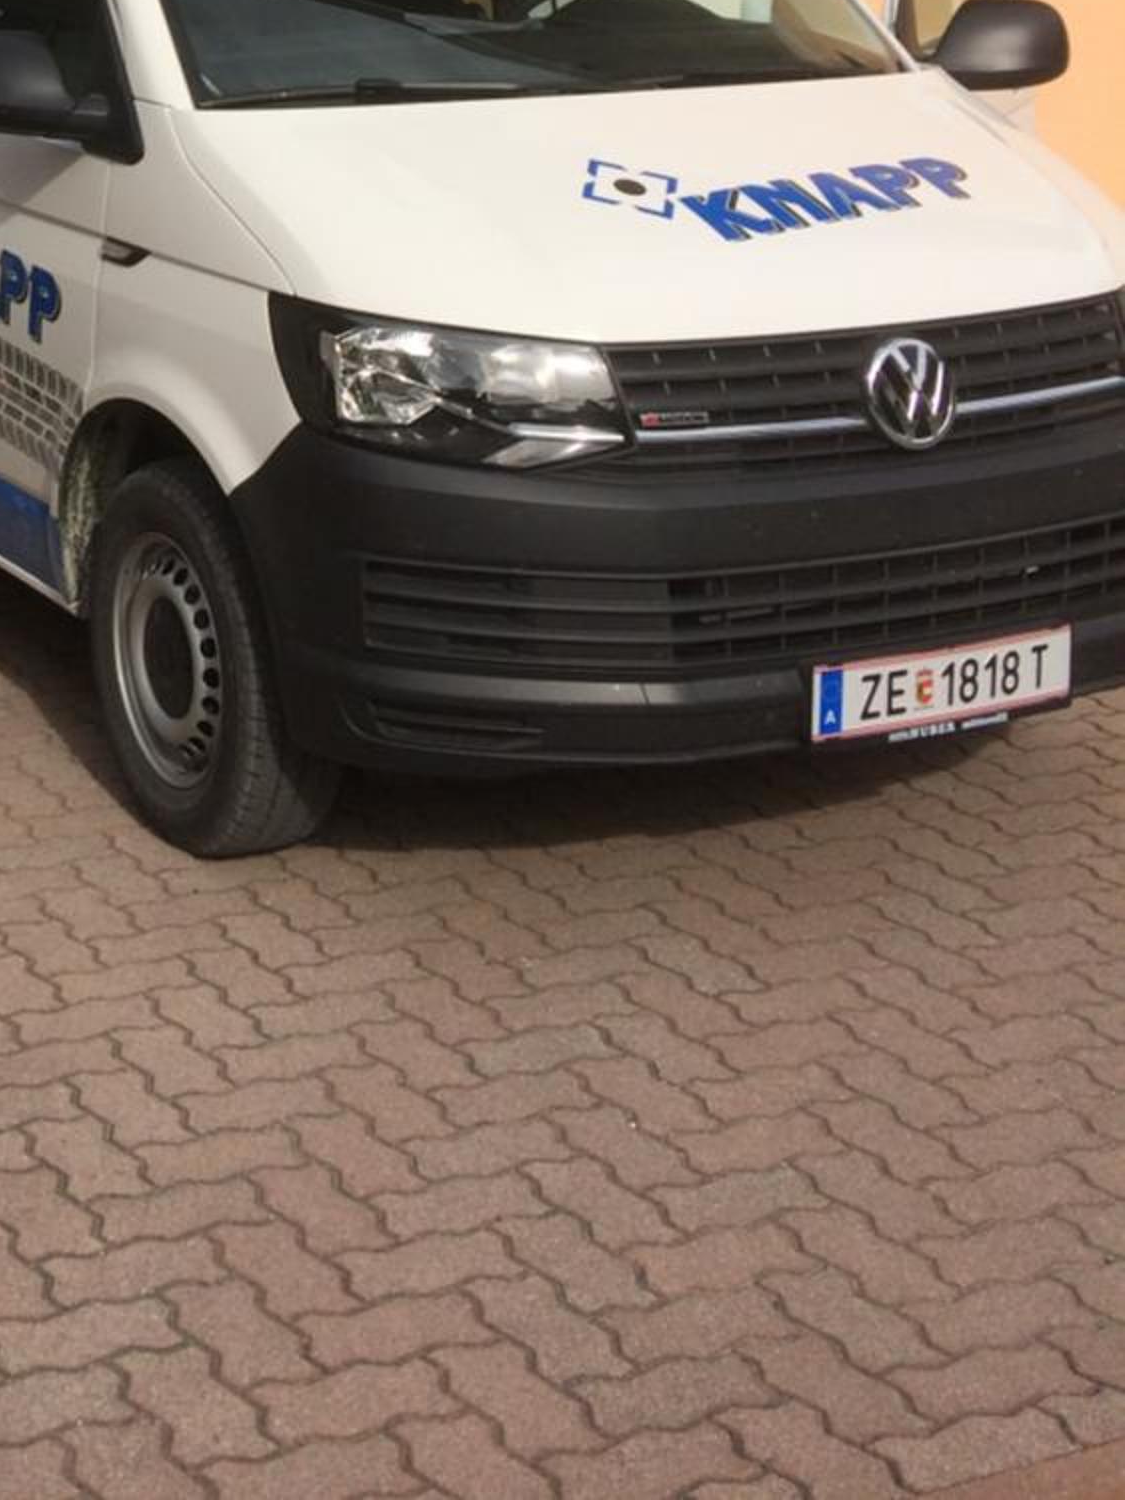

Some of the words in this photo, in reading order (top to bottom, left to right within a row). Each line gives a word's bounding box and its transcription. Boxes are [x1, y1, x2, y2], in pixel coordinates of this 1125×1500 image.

[677, 156, 972, 242] KNAPP
[860, 669, 909, 721] ZE
[941, 650, 1021, 706] 1818
[1031, 643, 1049, 689] T
